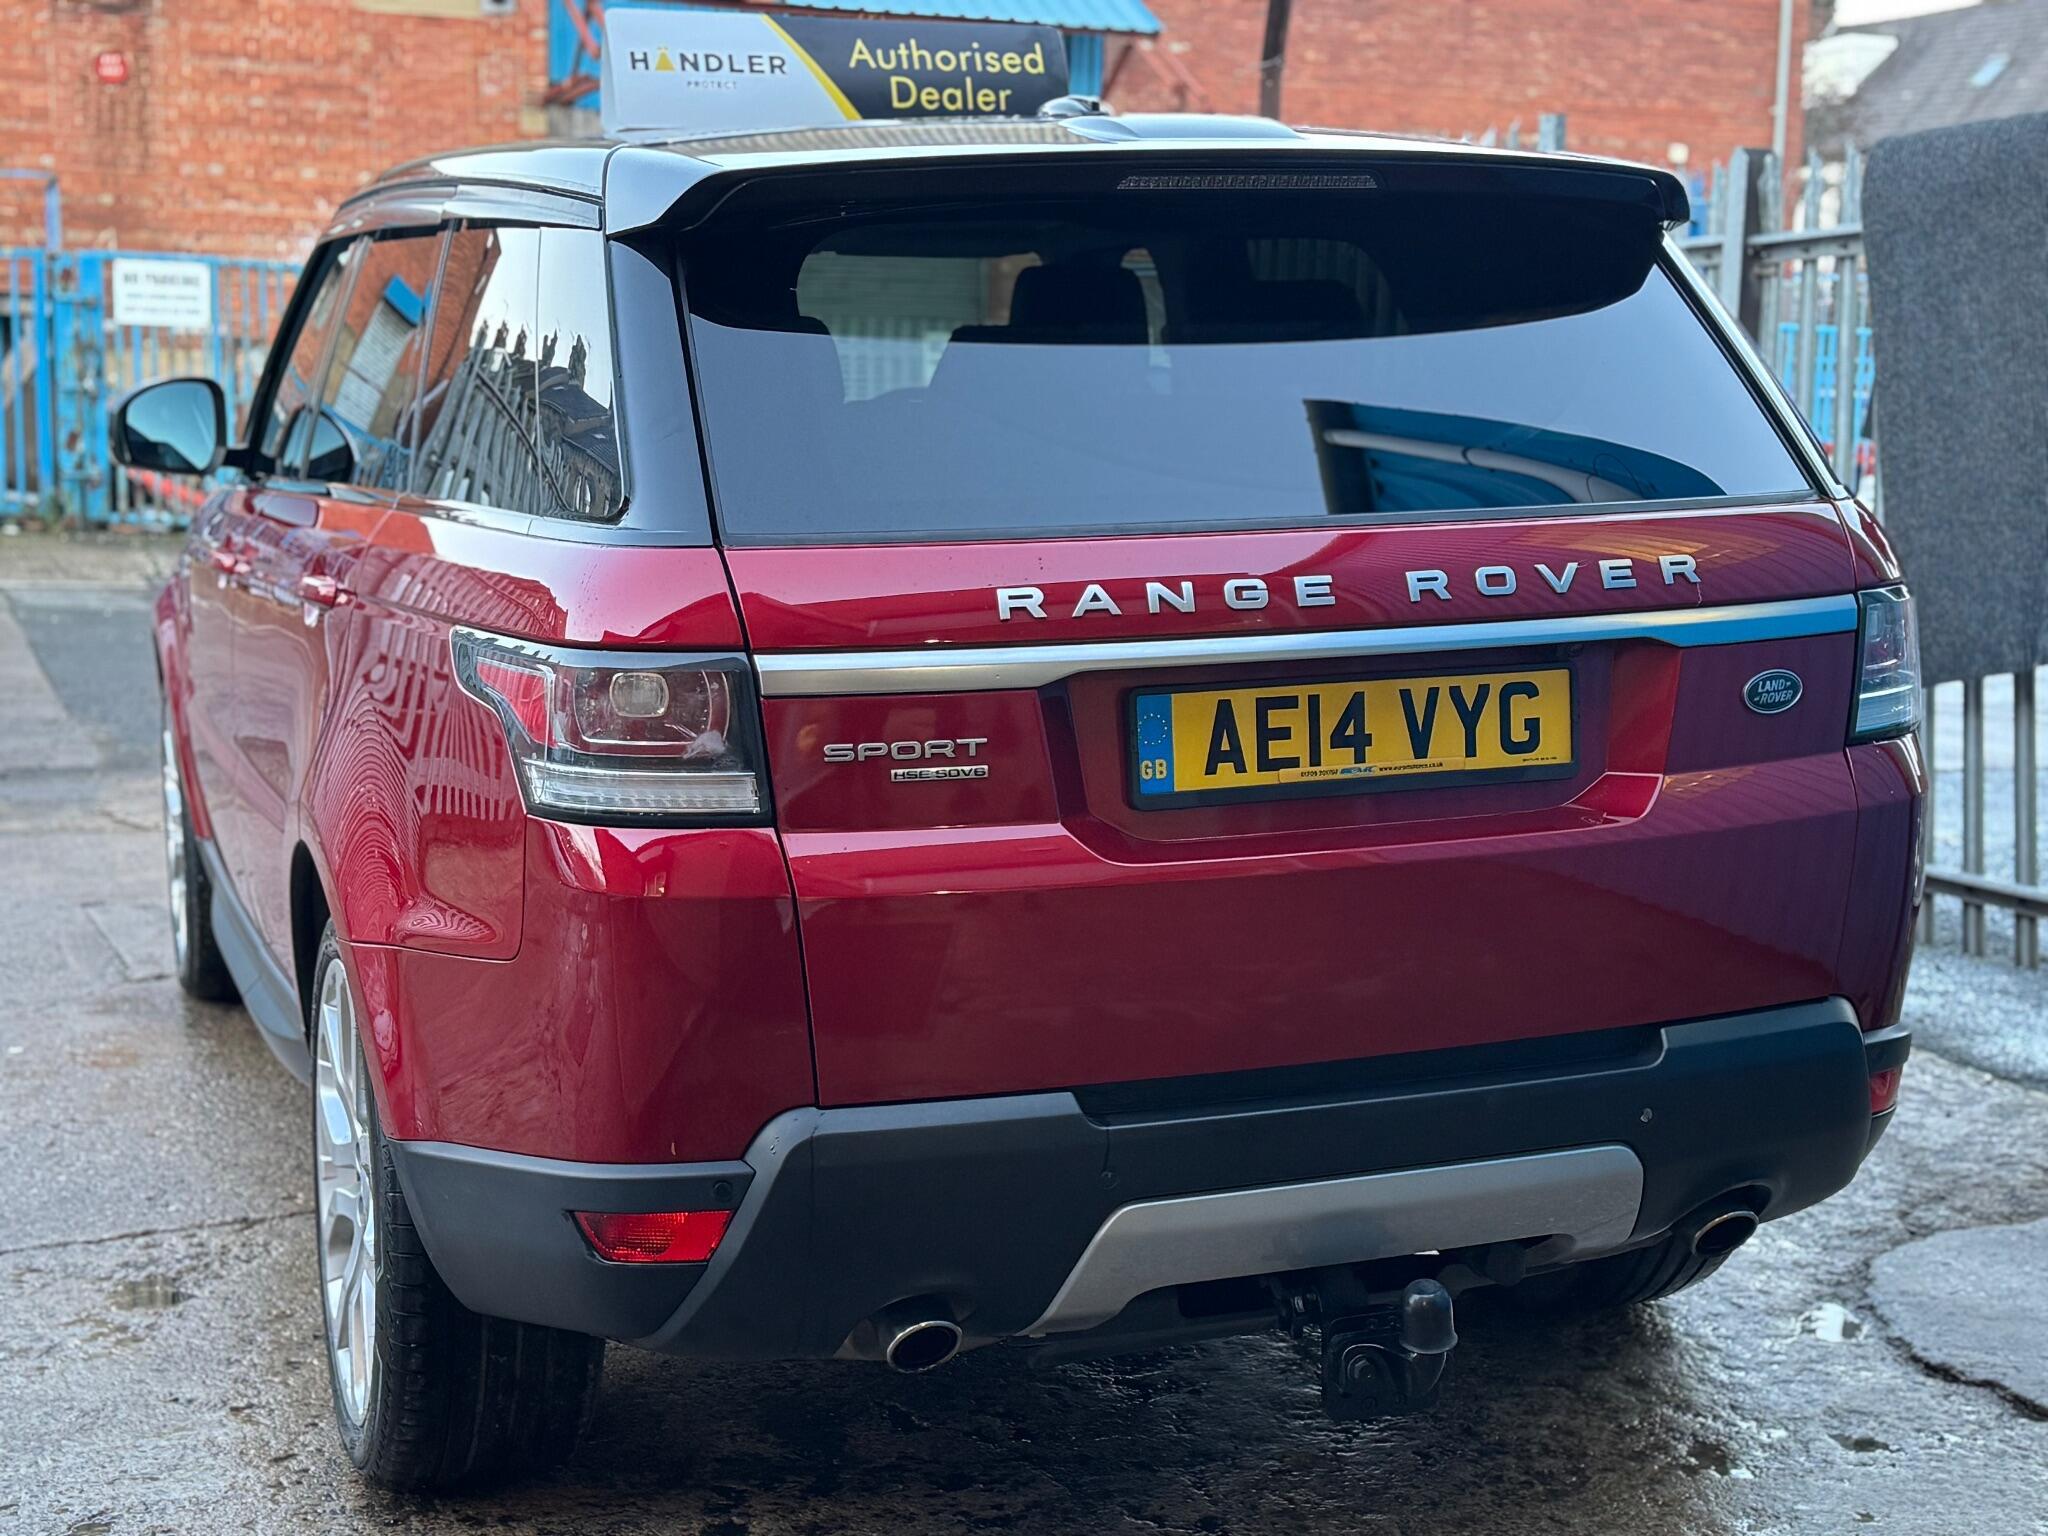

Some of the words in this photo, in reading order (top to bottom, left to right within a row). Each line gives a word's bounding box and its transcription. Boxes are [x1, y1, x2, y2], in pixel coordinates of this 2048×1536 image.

[849, 38, 1045, 75] Authorised
[686, 80, 737, 90] PROTECT
[891, 77, 1012, 111] Dealer
[997, 574, 1336, 621] RANGE
[1405, 554, 1702, 603] ROVER
[1758, 679, 1786, 693] LAND
[1760, 689, 1794, 704] ROVER
[1204, 691, 1373, 776] AE14
[1398, 681, 1540, 760] VYG
[823, 737, 988, 762] SPORT
[1140, 758, 1168, 781] GB
